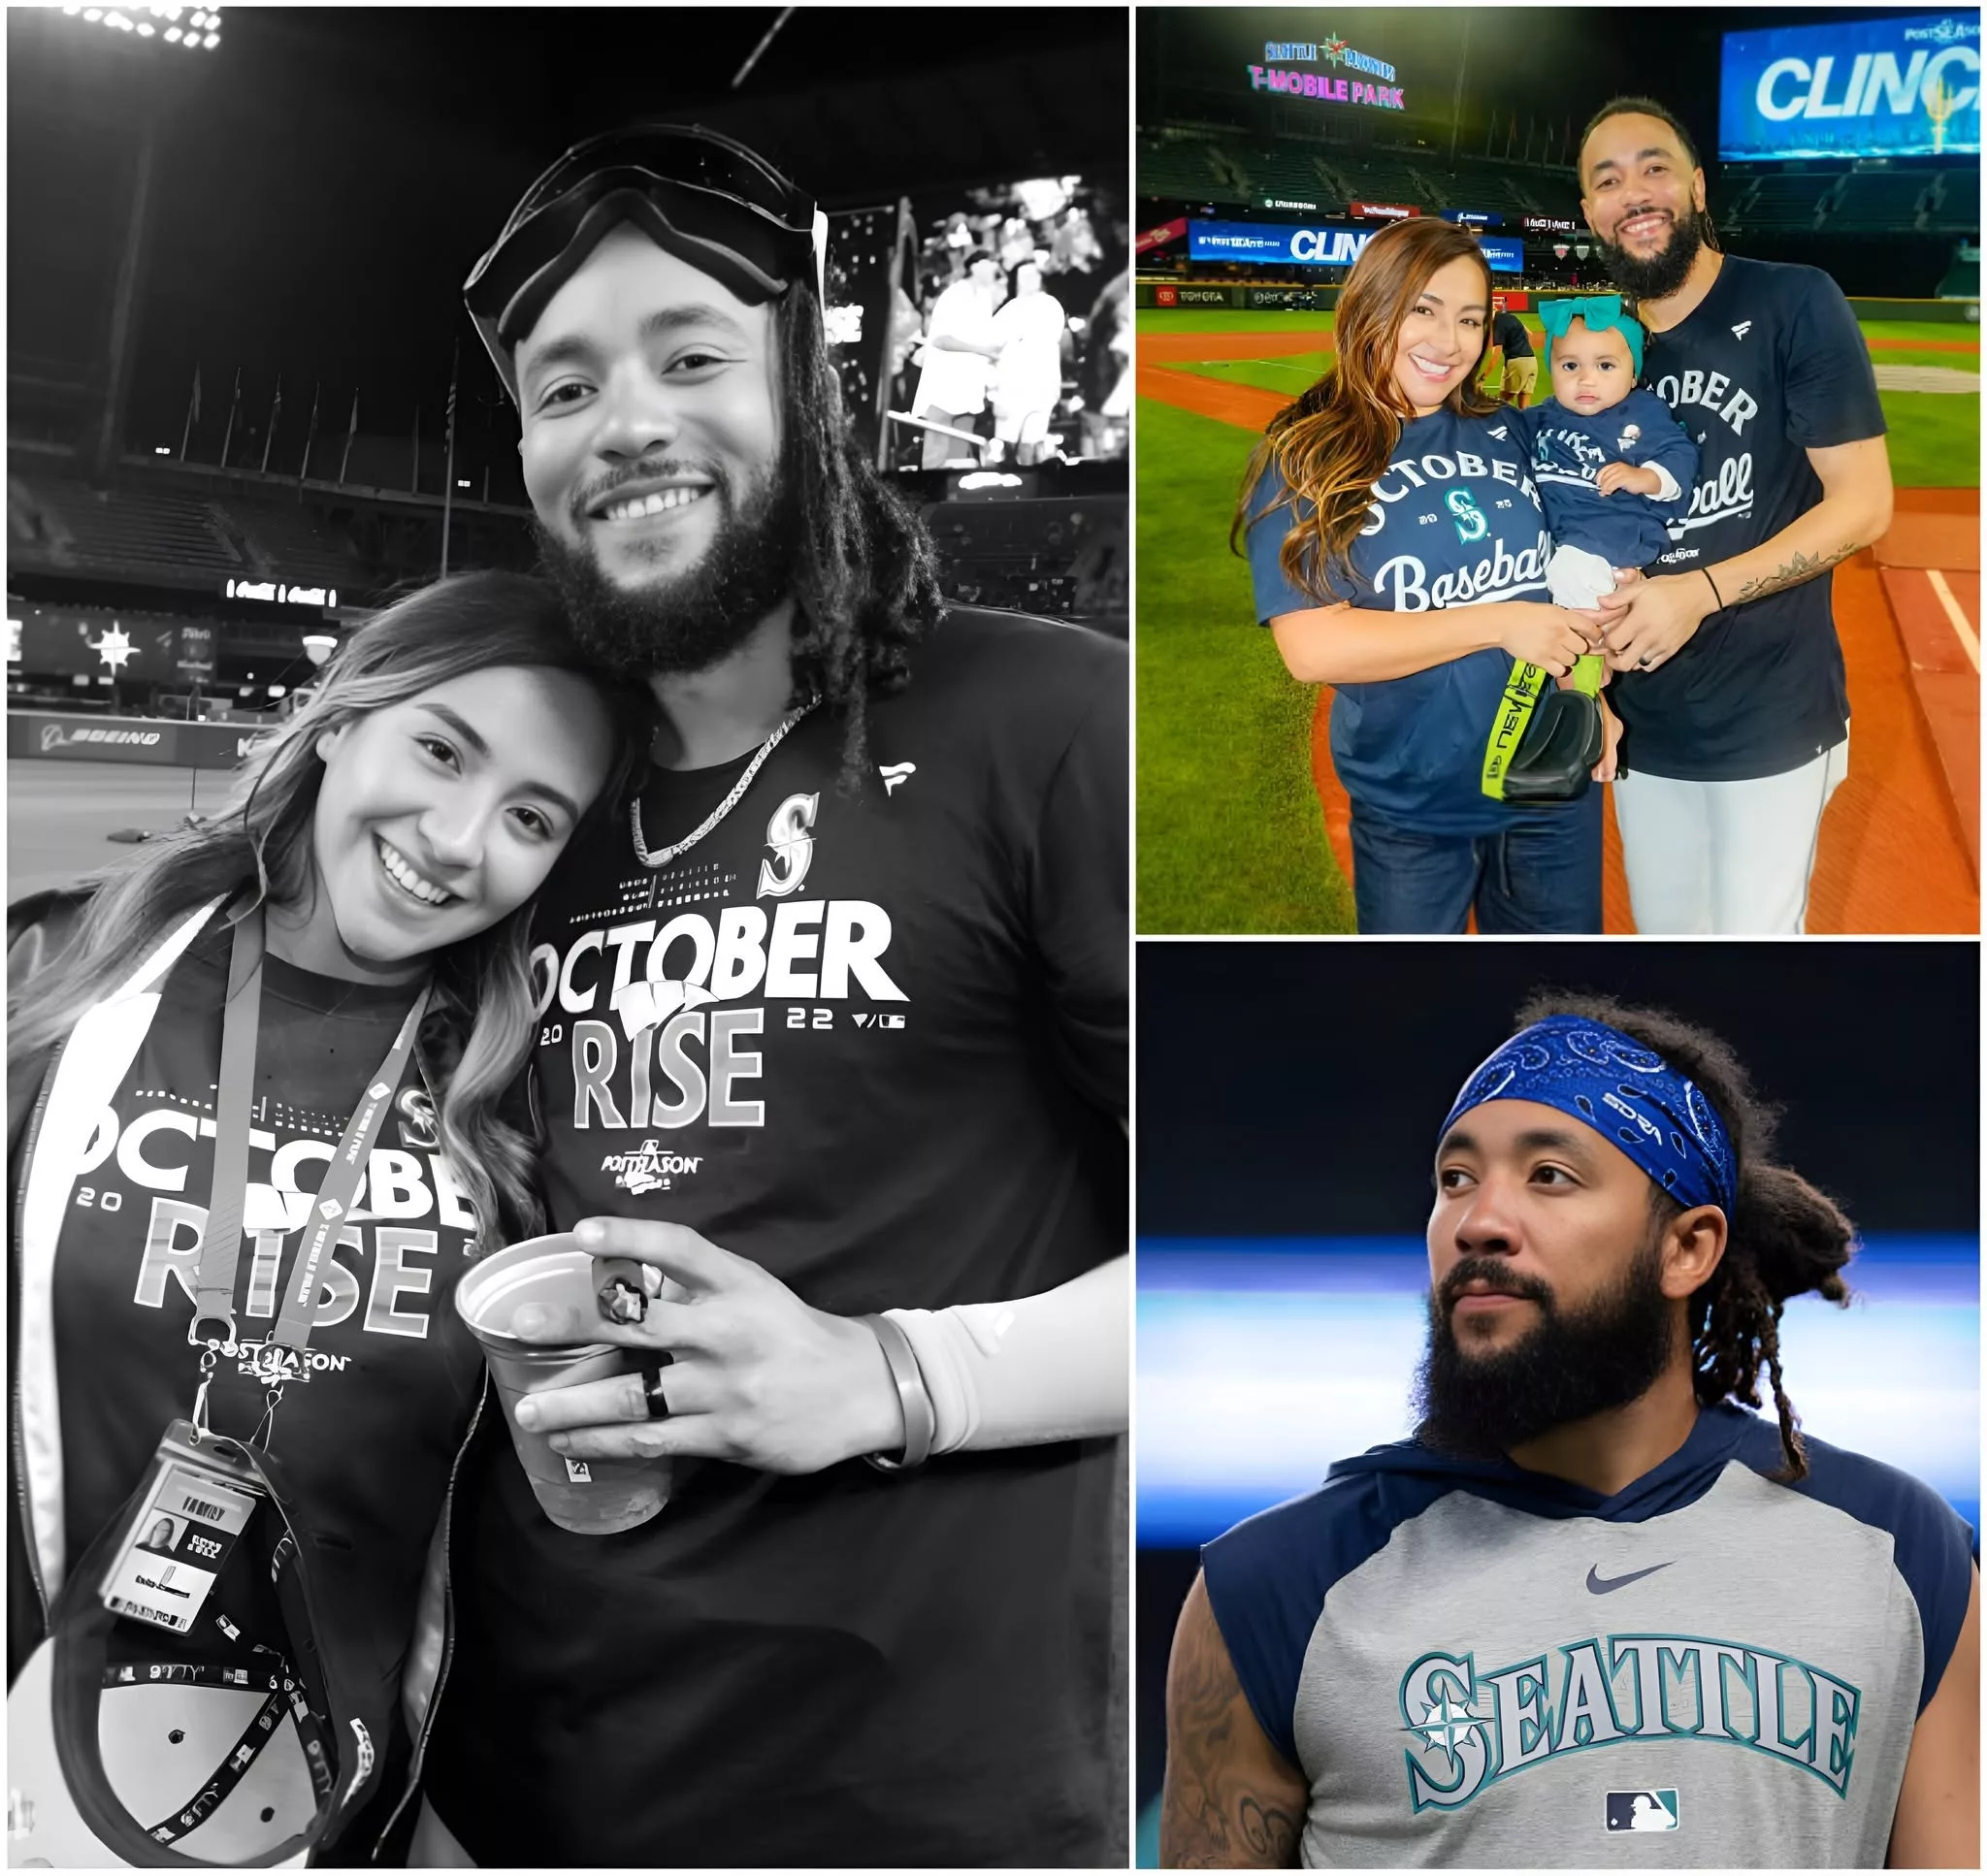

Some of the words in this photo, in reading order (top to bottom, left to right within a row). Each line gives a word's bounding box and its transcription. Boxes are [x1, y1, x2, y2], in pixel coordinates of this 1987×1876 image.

[1248, 64, 1349, 102] T-MOBILE
[1352, 81, 1406, 111] PARK
[1756, 46, 1980, 121] CLINC
[786, 1007, 833, 1030] 22
[571, 1007, 765, 1130] RISE
[76, 1186, 122, 1213] 20
[1399, 1633, 1862, 1815] SEATTLE
